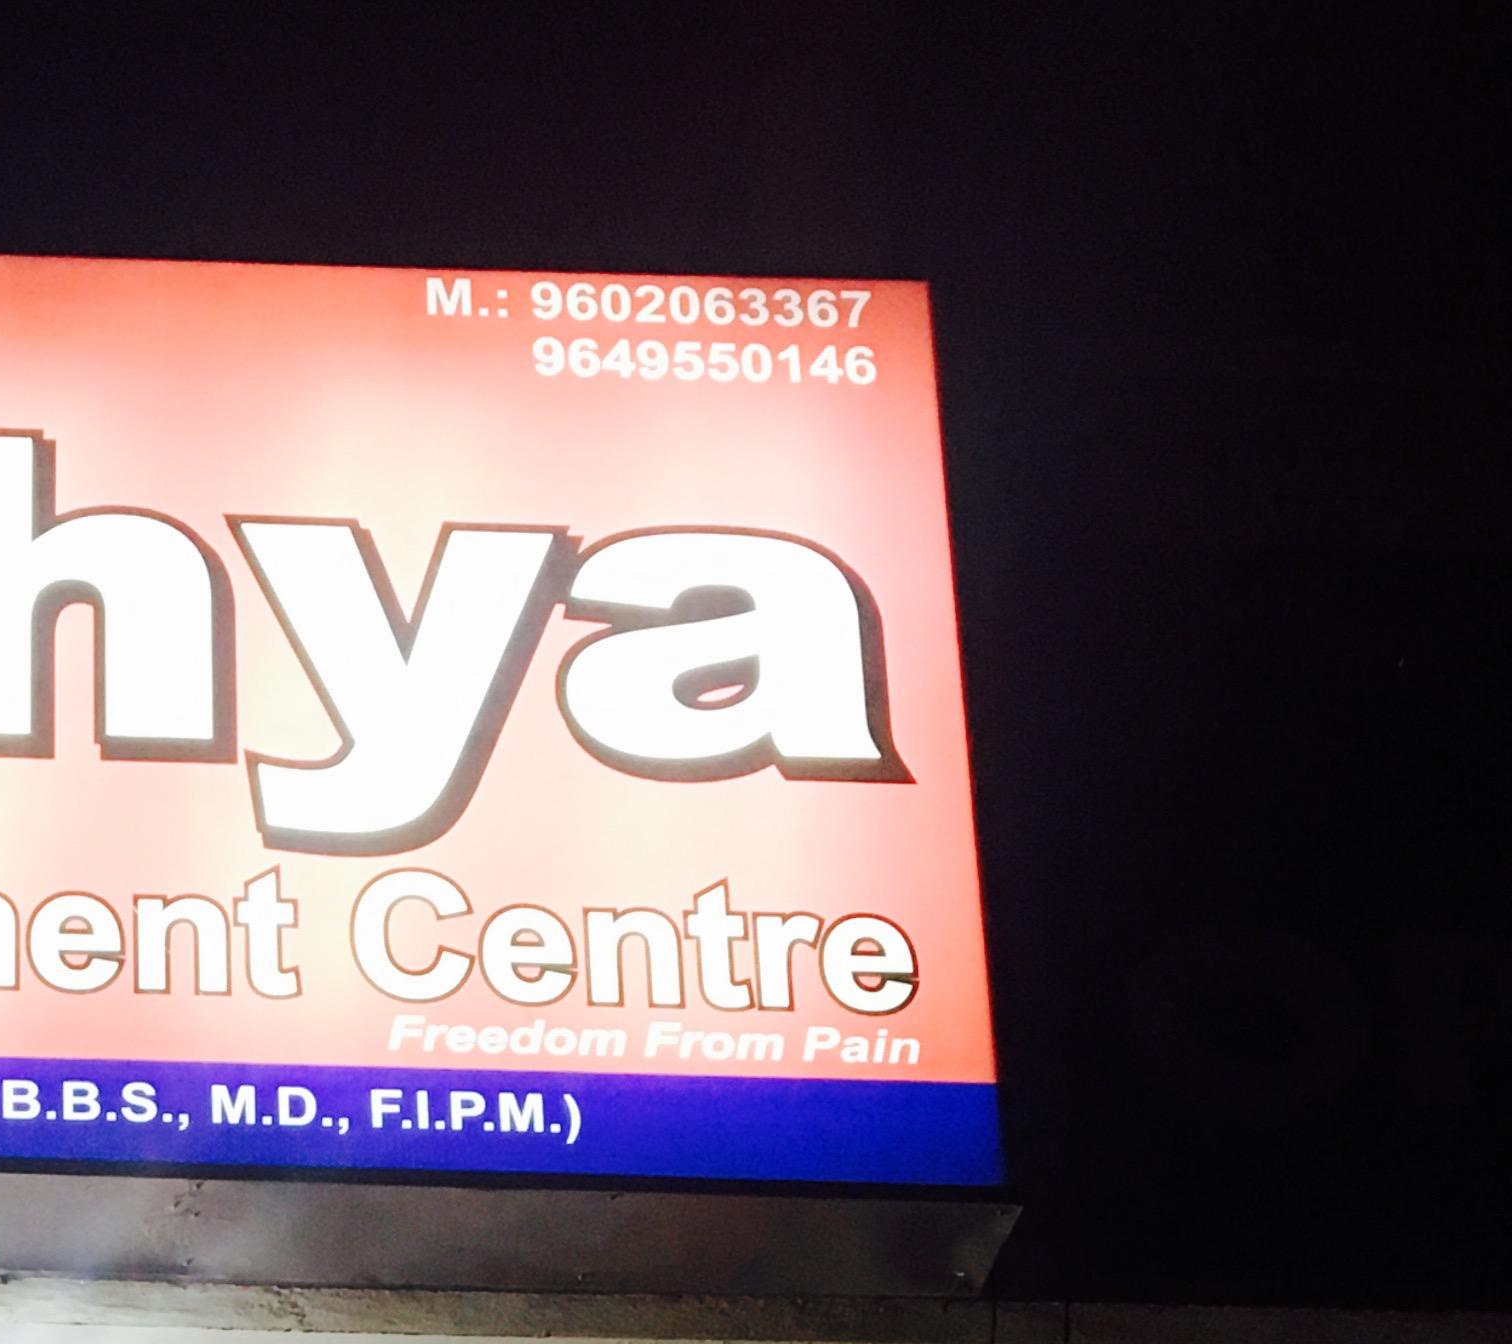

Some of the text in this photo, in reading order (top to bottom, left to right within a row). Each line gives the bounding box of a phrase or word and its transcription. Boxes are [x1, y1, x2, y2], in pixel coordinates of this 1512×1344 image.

[425, 276, 871, 330] M.: 9602063367
[531, 335, 878, 387] 9649550146
[350, 867, 921, 1015] Centre
[388, 1014, 921, 1066] Freedom From Pain
